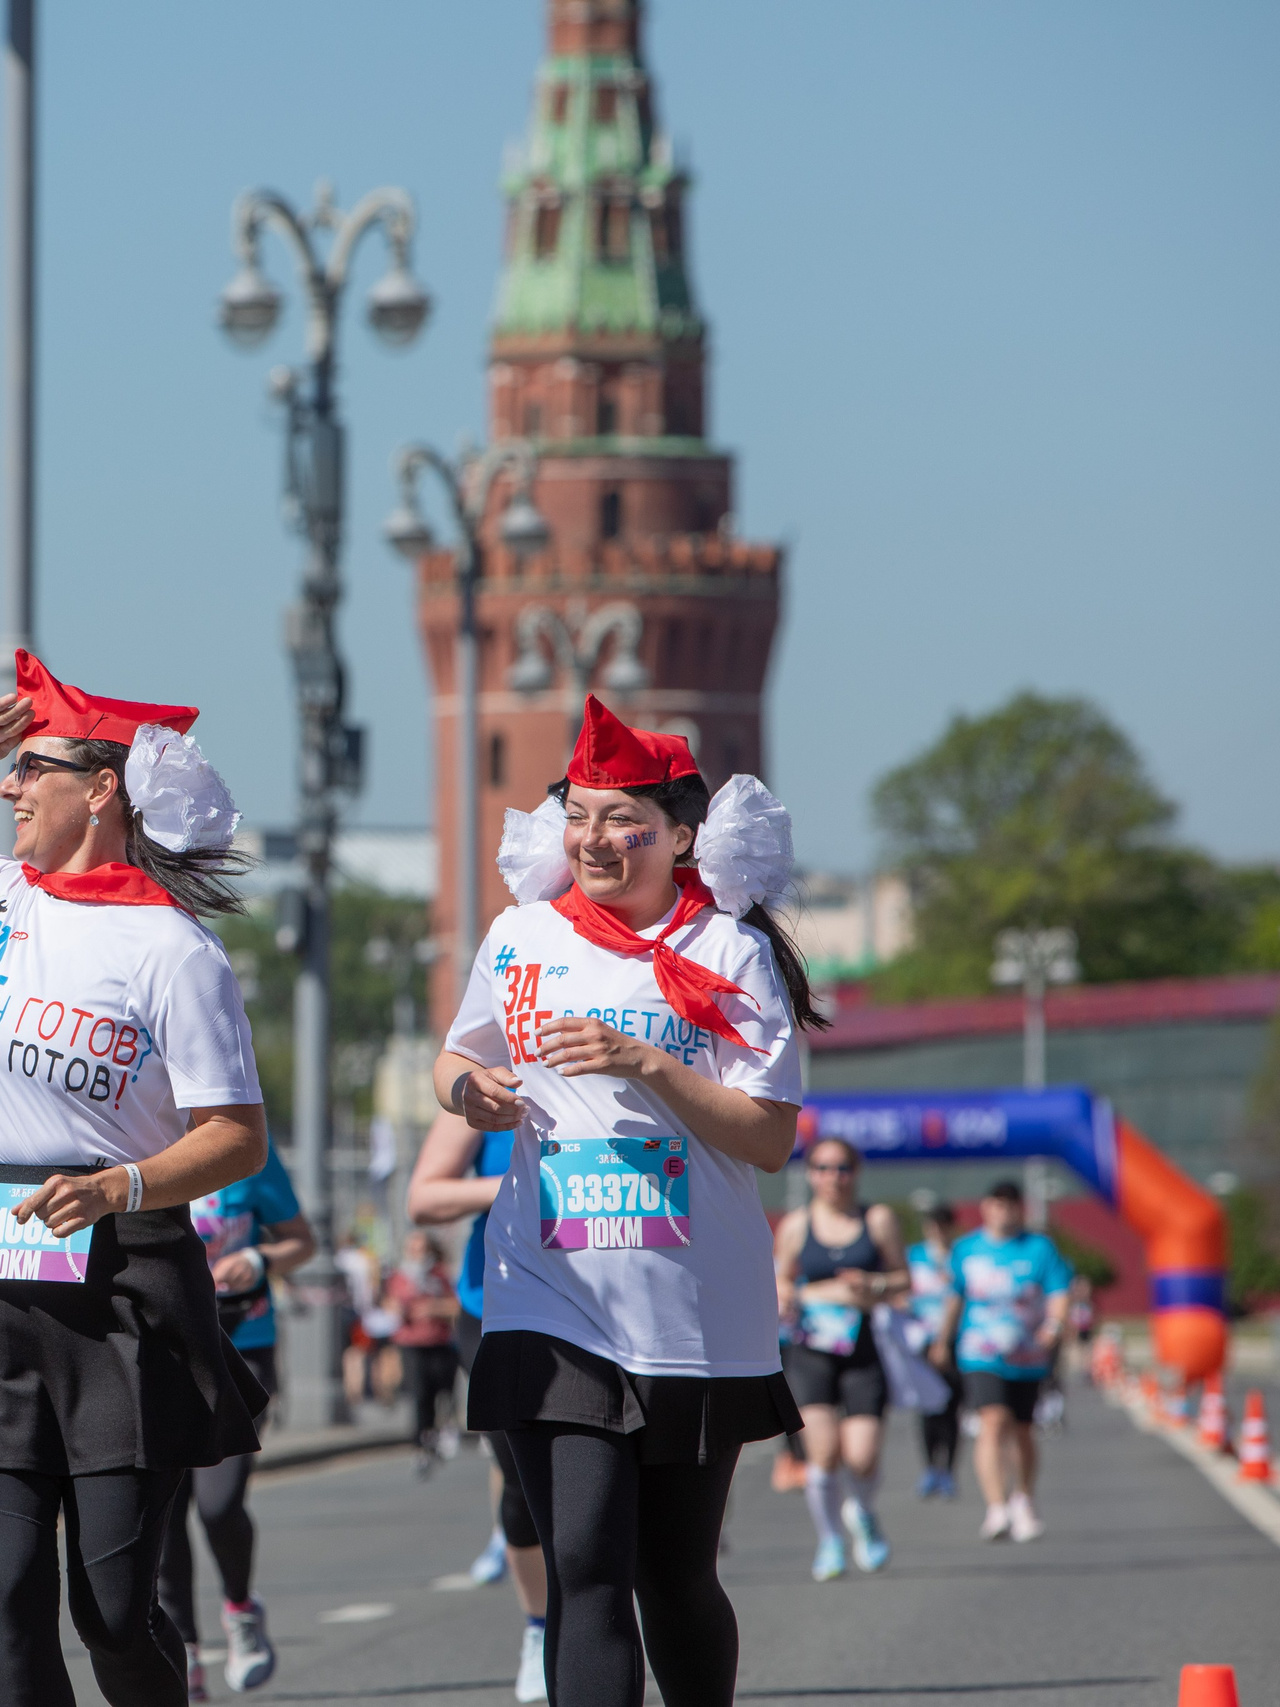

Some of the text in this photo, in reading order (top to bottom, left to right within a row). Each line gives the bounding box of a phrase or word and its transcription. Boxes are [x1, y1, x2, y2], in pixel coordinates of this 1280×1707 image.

[14, 997, 153, 1083] ГОТОВ?
[8, 1040, 128, 1110] ГОТОВ!
[560, 1143, 581, 1152] ПСБ
[567, 1173, 661, 1213] 33370
